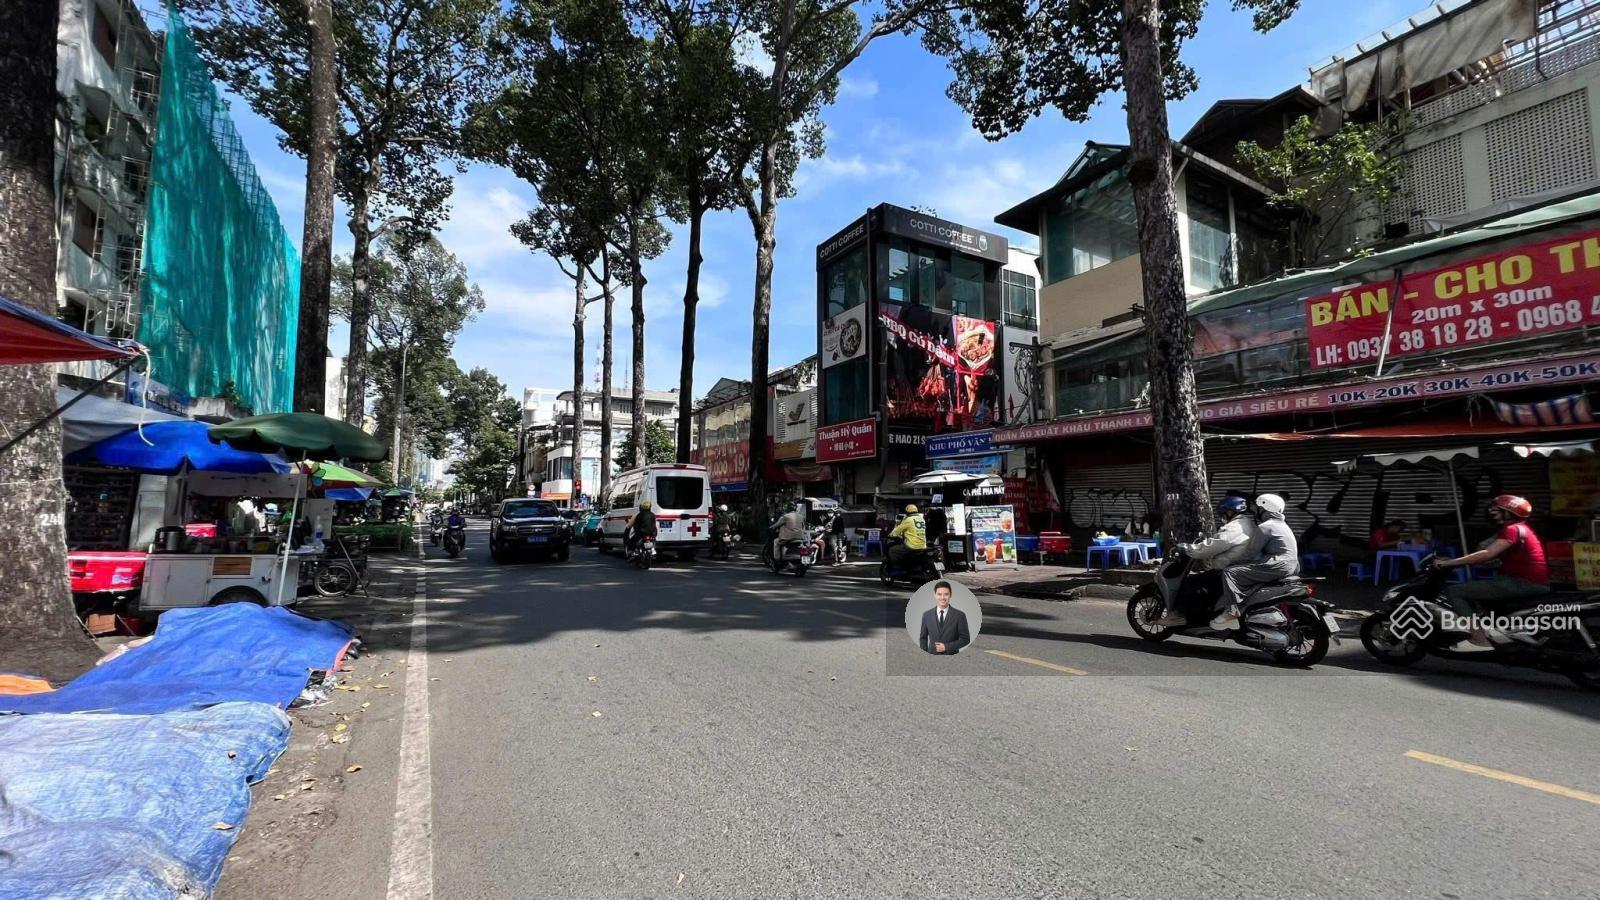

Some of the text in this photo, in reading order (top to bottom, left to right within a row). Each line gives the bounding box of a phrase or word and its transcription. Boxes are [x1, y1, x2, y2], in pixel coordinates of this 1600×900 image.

[820, 224, 864, 258] COTTI COFFEE
[910, 219, 937, 233] COTTI
[938, 227, 973, 244] COFFEE
[1311, 287, 1389, 327] BÁN
[1434, 254, 1533, 300] CHO
[1411, 285, 1552, 325] 20m x 30m
[1316, 344, 1343, 366] LH:
[1399, 329, 1425, 351] 38
[1432, 322, 1458, 346] 18
[1465, 316, 1493, 341] 28
[1517, 299, 1583, 332] 0968
[1094, 418, 1132, 430] THANH
[1136, 414, 1152, 425] LÝ
[1219, 404, 1243, 417] GIÁ
[1250, 397, 1289, 413] SIÊU
[895, 433, 912, 444] MAO
[929, 442, 946, 452] KHU
[948, 437, 966, 449] PHỐ
